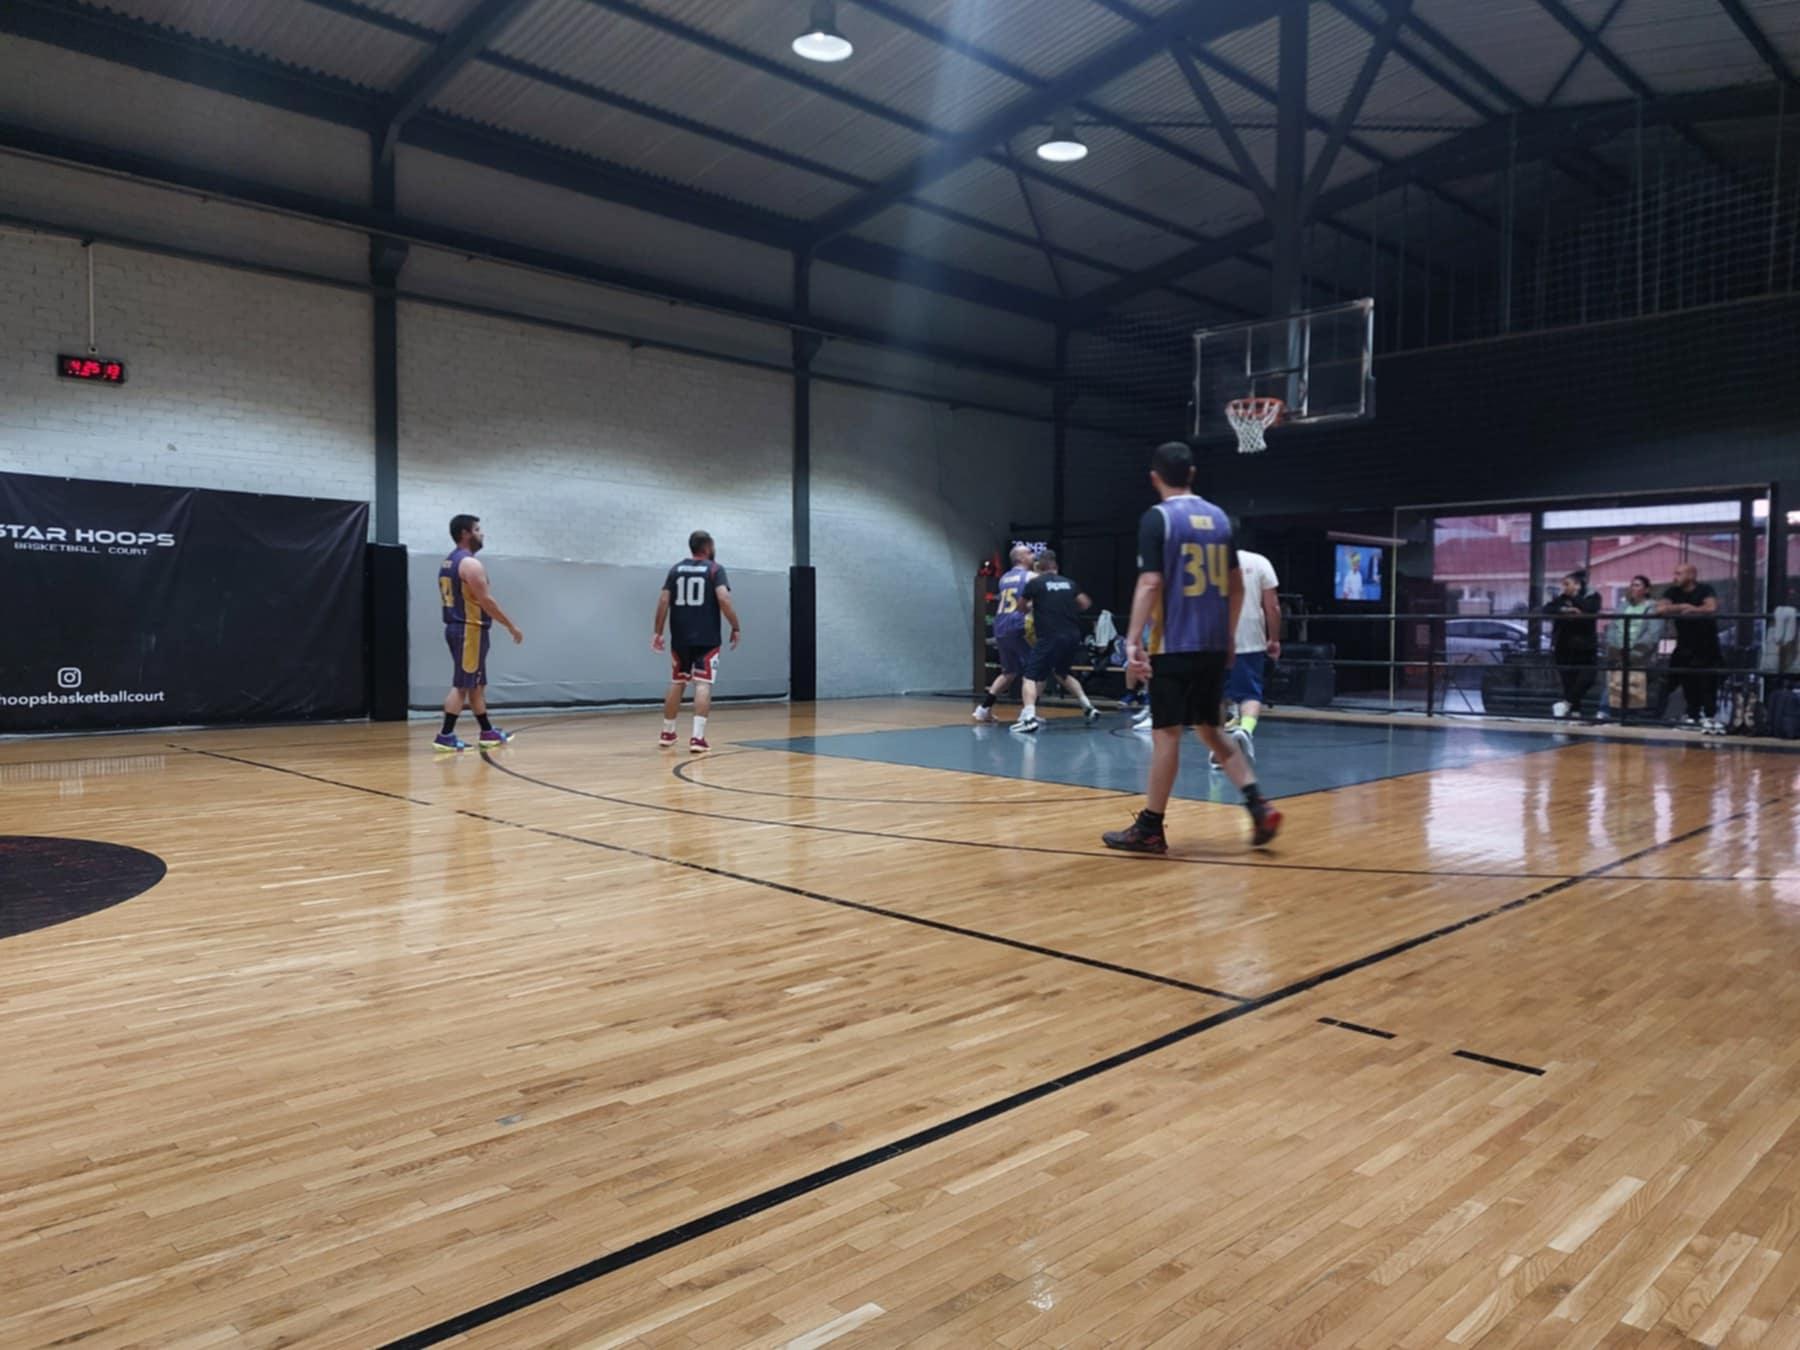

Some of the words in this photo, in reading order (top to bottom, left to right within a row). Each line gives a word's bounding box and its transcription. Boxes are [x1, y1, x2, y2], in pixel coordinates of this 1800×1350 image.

[14, 541, 100, 554] BASKETBALL
[108, 546, 149, 556] COURT
[75, 528, 176, 547] HOOPS
[1181, 543, 1229, 597] 34
[675, 576, 705, 606] 10
[997, 587, 1018, 614] 15
